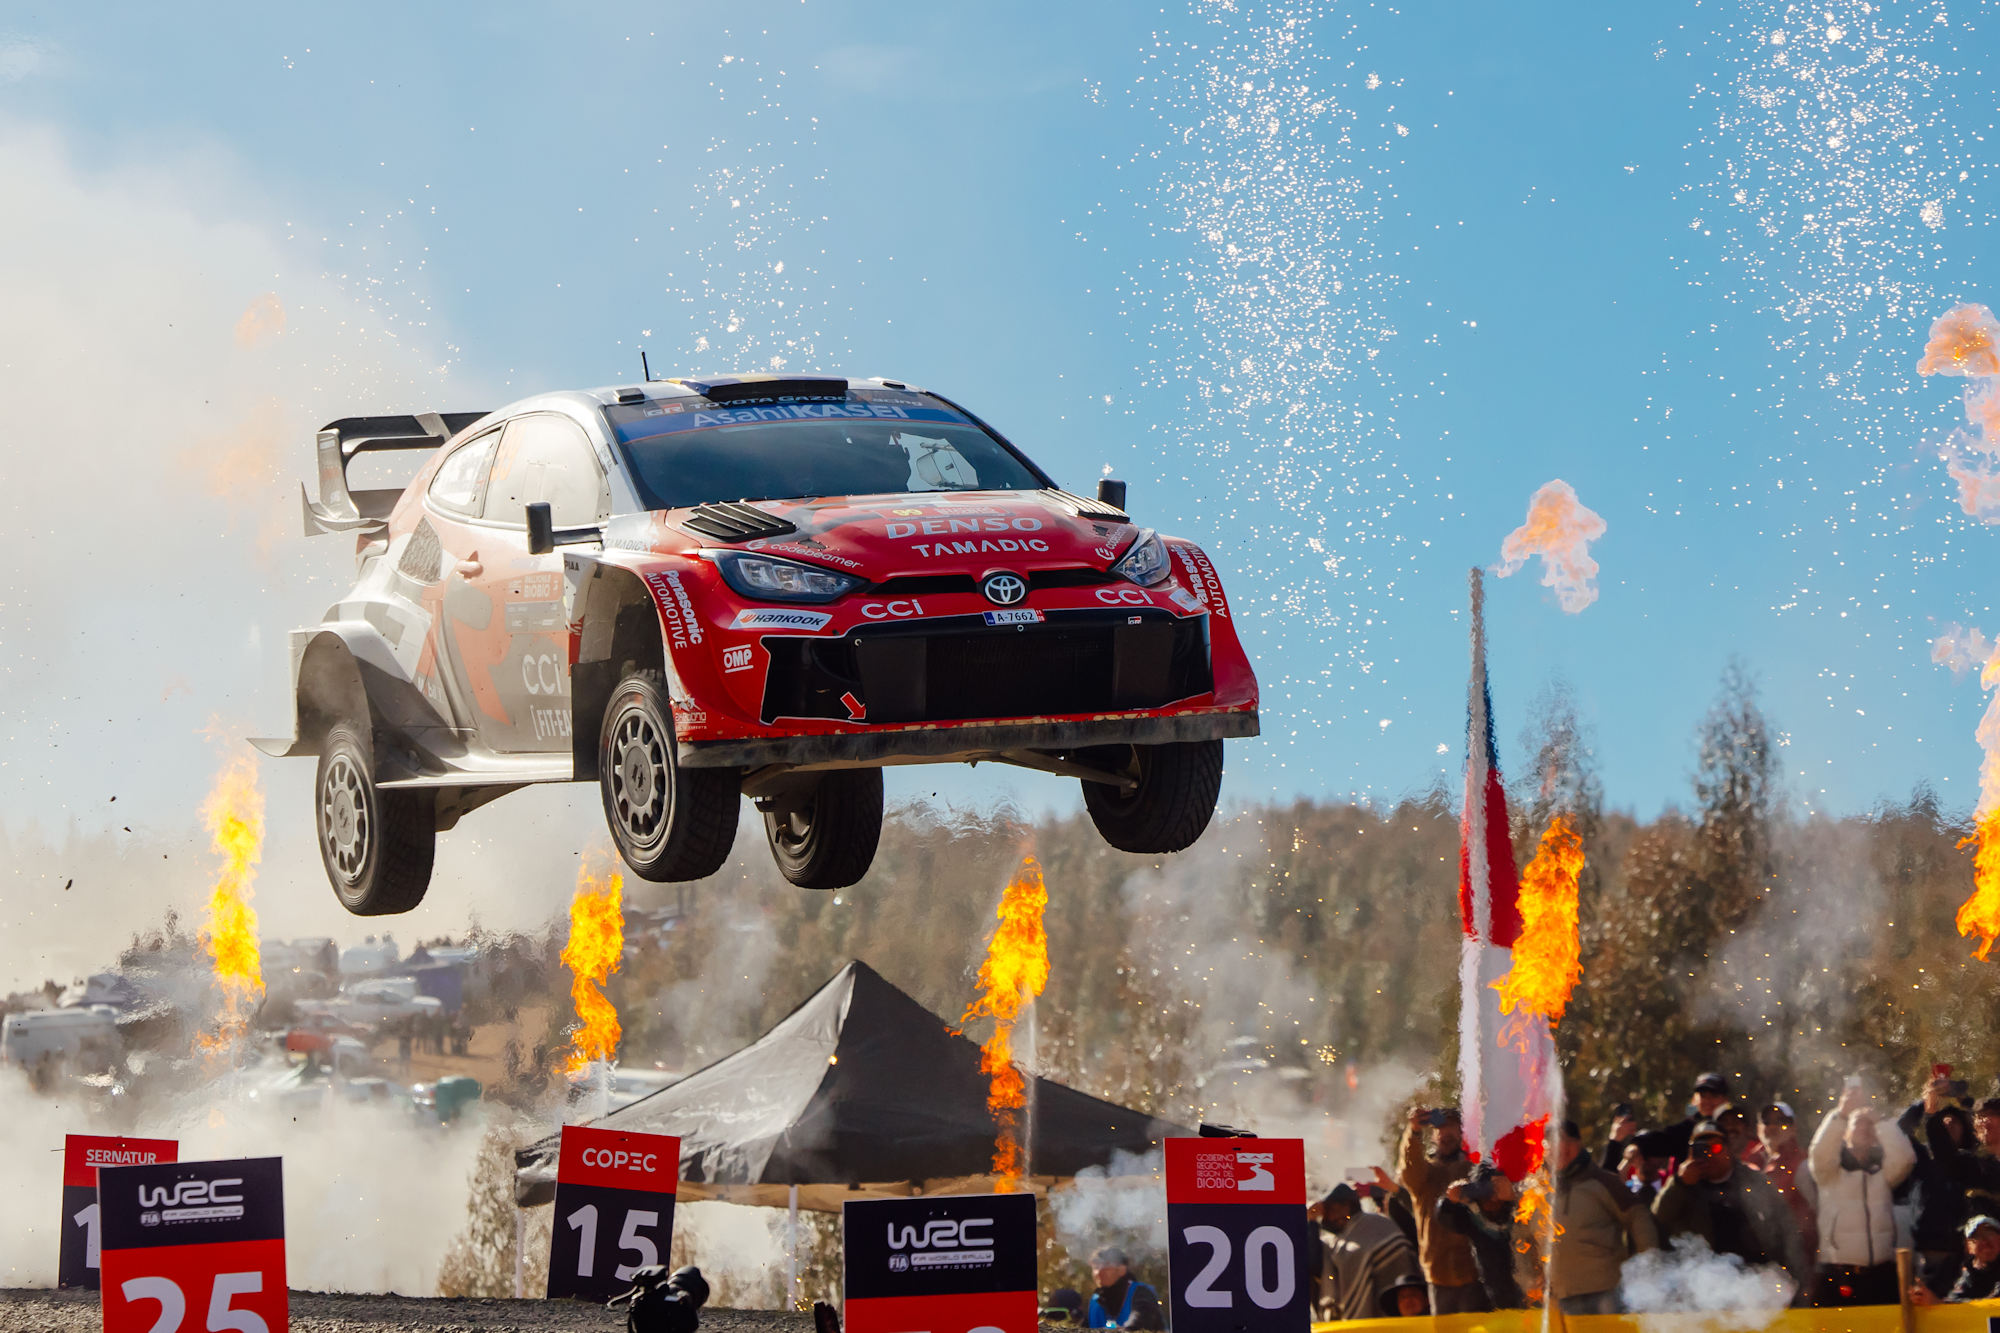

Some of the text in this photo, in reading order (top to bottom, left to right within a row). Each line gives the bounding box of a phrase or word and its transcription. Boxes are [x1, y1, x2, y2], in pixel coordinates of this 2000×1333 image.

[689, 397, 773, 410] TOYOTA
[886, 517, 1043, 540] DENSO
[770, 543, 861, 569] codebeamer
[911, 538, 1050, 558] TAMADIC
[1183, 543, 1228, 618] AUTOMOTIVE
[645, 572, 688, 650] AUTOMOTIVE
[661, 569, 703, 645] Panasonic
[997, 611, 1035, 622] A-7662
[723, 648, 753, 669] OMP
[86, 1149, 157, 1164] SERNATUR
[582, 1147, 658, 1173] COPEC
[139, 1178, 243, 1207] WRC
[567, 1203, 660, 1283] 15
[888, 1218, 994, 1249] WRC
[1183, 1225, 1296, 1310] 20
